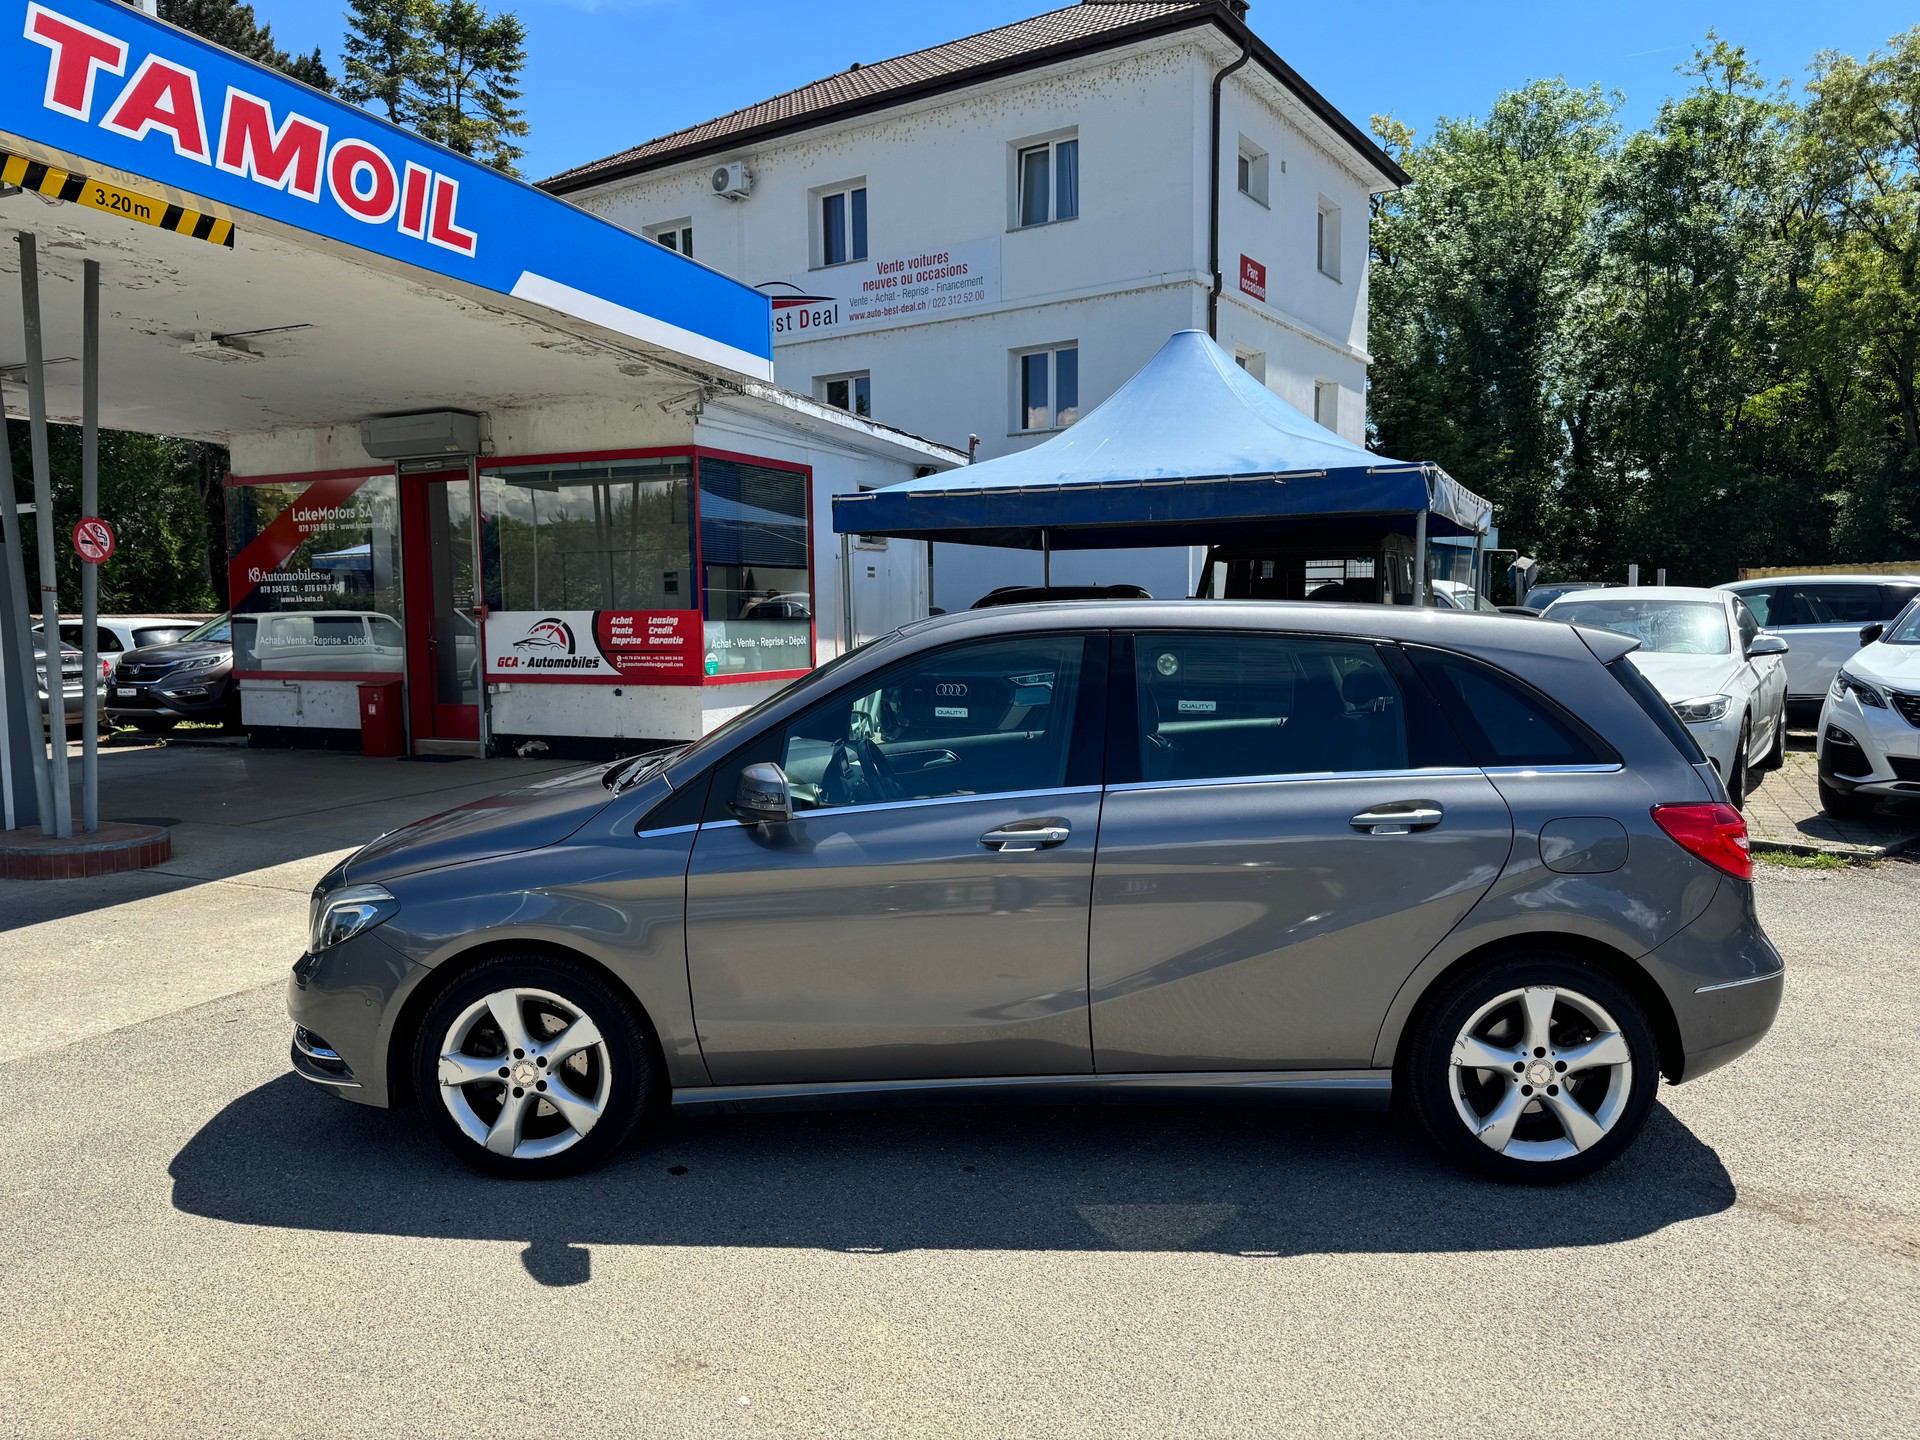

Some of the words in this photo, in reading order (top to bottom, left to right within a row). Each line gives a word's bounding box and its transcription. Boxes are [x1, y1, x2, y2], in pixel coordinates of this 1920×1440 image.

[24, 1, 477, 258] TAMOIL
[95, 188, 132, 213] 3.20
[134, 203, 150, 219] m
[876, 259, 905, 275] Vente
[907, 252, 949, 270] voitures
[862, 276, 898, 292] neuves
[900, 273, 913, 286] ou
[916, 263, 968, 283] occasions
[849, 296, 869, 307] Vente
[875, 291, 896, 303] Achat
[902, 286, 929, 299] Reprise
[936, 275, 984, 293] Financement
[848, 300, 926, 321] www.auto-best-deal.ch
[932, 296, 947, 308] 022
[948, 294, 962, 306] 312
[963, 292, 973, 303] 52
[975, 290, 985, 301] 00
[799, 304, 839, 328] Deal
[292, 506, 356, 522] LakeMotors
[359, 504, 373, 518] SA
[260, 568, 321, 582] Automobiles
[610, 616, 633, 625] Achat
[648, 616, 679, 626] Leasing
[611, 626, 633, 634] Vente
[648, 626, 673, 634] Credit
[260, 635, 281, 645] Achat
[286, 635, 307, 645] Vente
[313, 635, 341, 647] Reprise
[347, 635, 371, 646] Dépôt
[611, 636, 642, 646] Reprise
[648, 636, 684, 645] Garantie
[711, 639, 732, 649] Achat
[736, 638, 756, 648] Vente
[760, 637, 784, 648] Reprise
[788, 635, 807, 647] Dépôt
[497, 656, 519, 668] GCA
[526, 656, 600, 668] Automobiles
